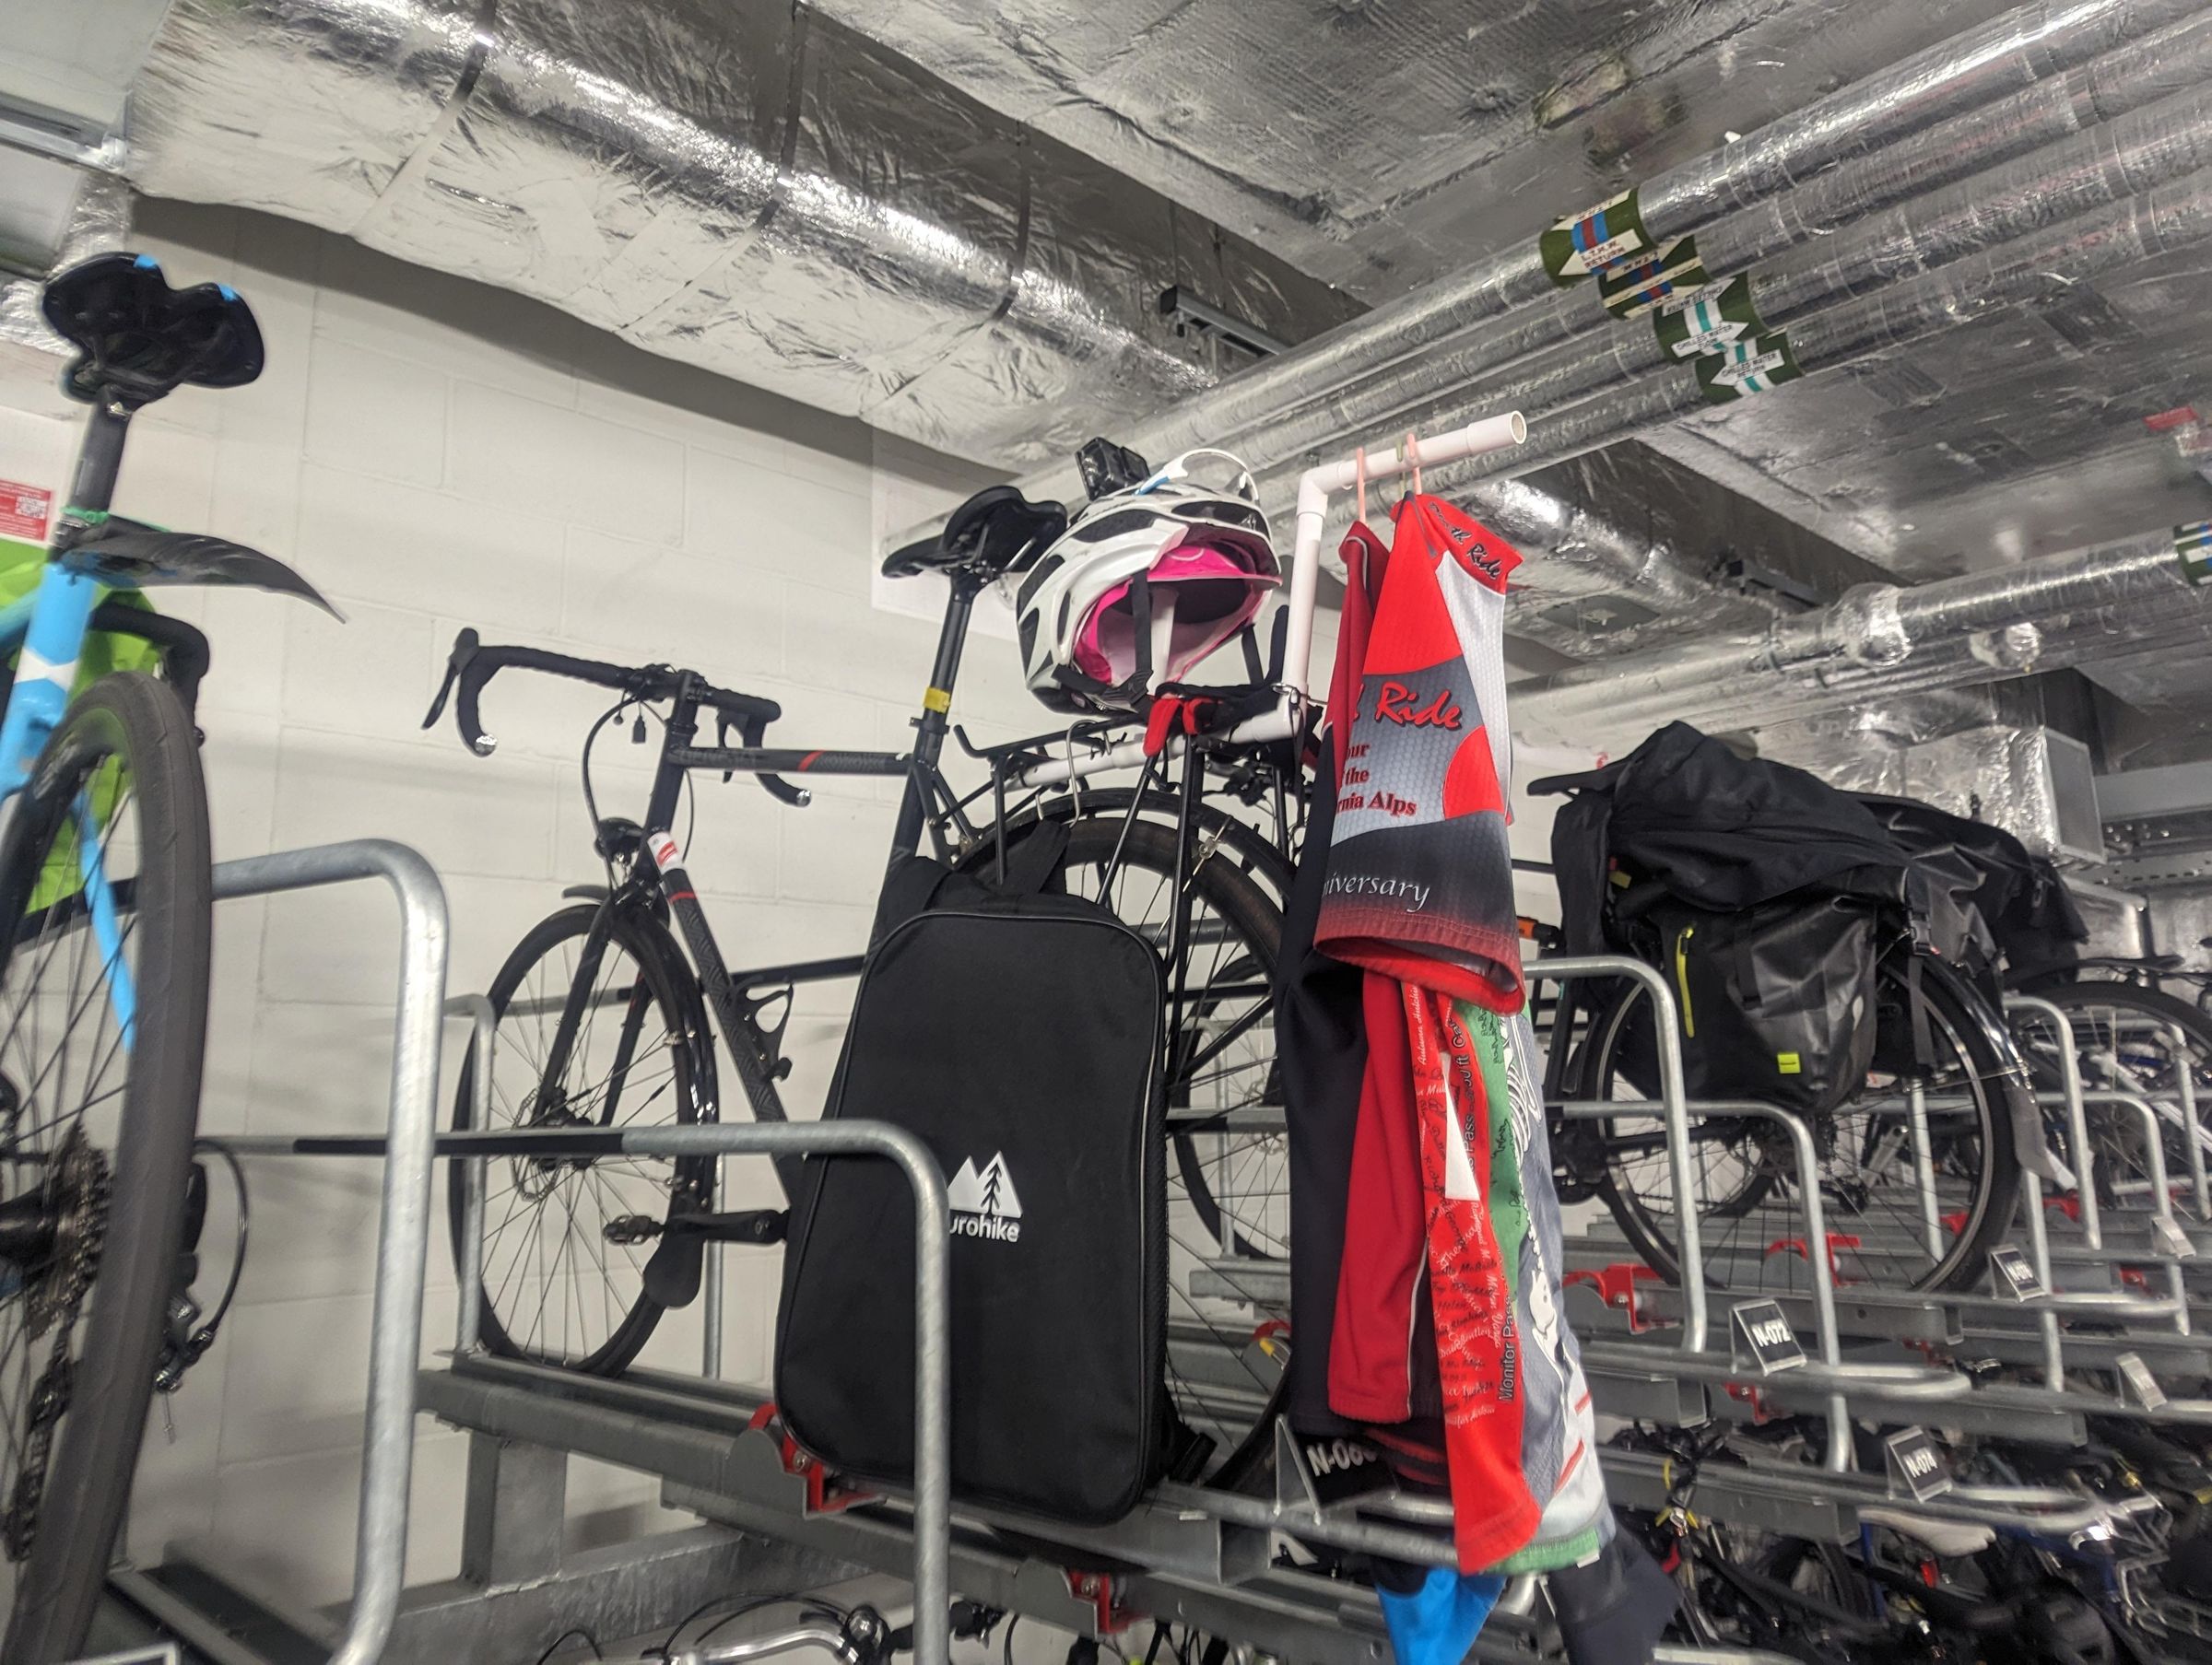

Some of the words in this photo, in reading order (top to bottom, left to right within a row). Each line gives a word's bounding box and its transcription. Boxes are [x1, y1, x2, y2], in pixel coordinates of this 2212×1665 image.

[1465, 543, 1502, 580] Ride
[1374, 680, 1463, 732] Ride
[1367, 790, 1418, 818] Alps
[949, 1214, 1021, 1243] urohike
[1751, 1319, 1792, 1347] N-072
[1499, 1342, 1516, 1401] Monitor
[1902, 1448, 1938, 1478] N-074
